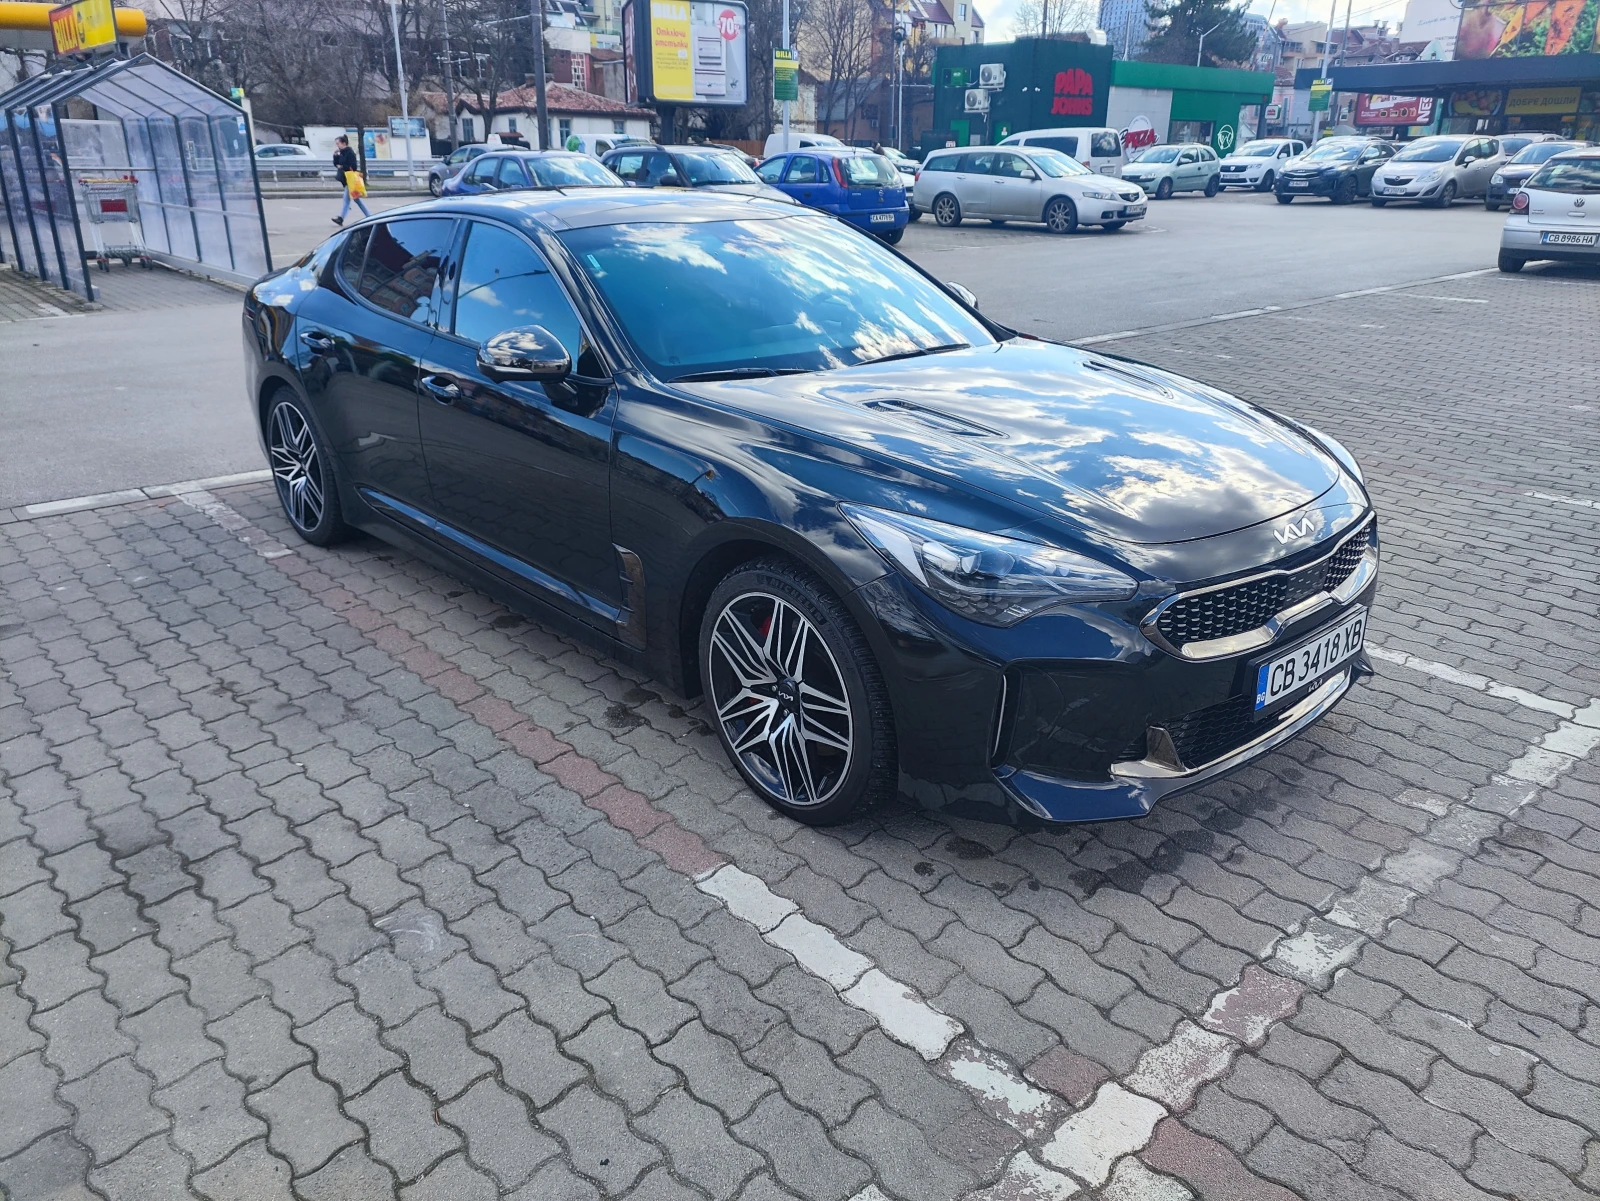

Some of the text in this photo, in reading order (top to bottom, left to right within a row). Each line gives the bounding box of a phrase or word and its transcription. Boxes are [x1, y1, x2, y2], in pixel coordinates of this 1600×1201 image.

[652, 3, 687, 21] BILLA
[775, 50, 792, 59] BILLA
[1054, 68, 1093, 95] PAPA
[1051, 97, 1093, 116] JOHNS
[1508, 96, 1576, 108] ДОБРЕ ДОШЛИ
[1548, 234, 1593, 244] CB 8986 HA
[770, 578, 822, 624] MICHELIN
[1270, 619, 1363, 697] CB 3418 XB
[1256, 691, 1266, 703] BG
